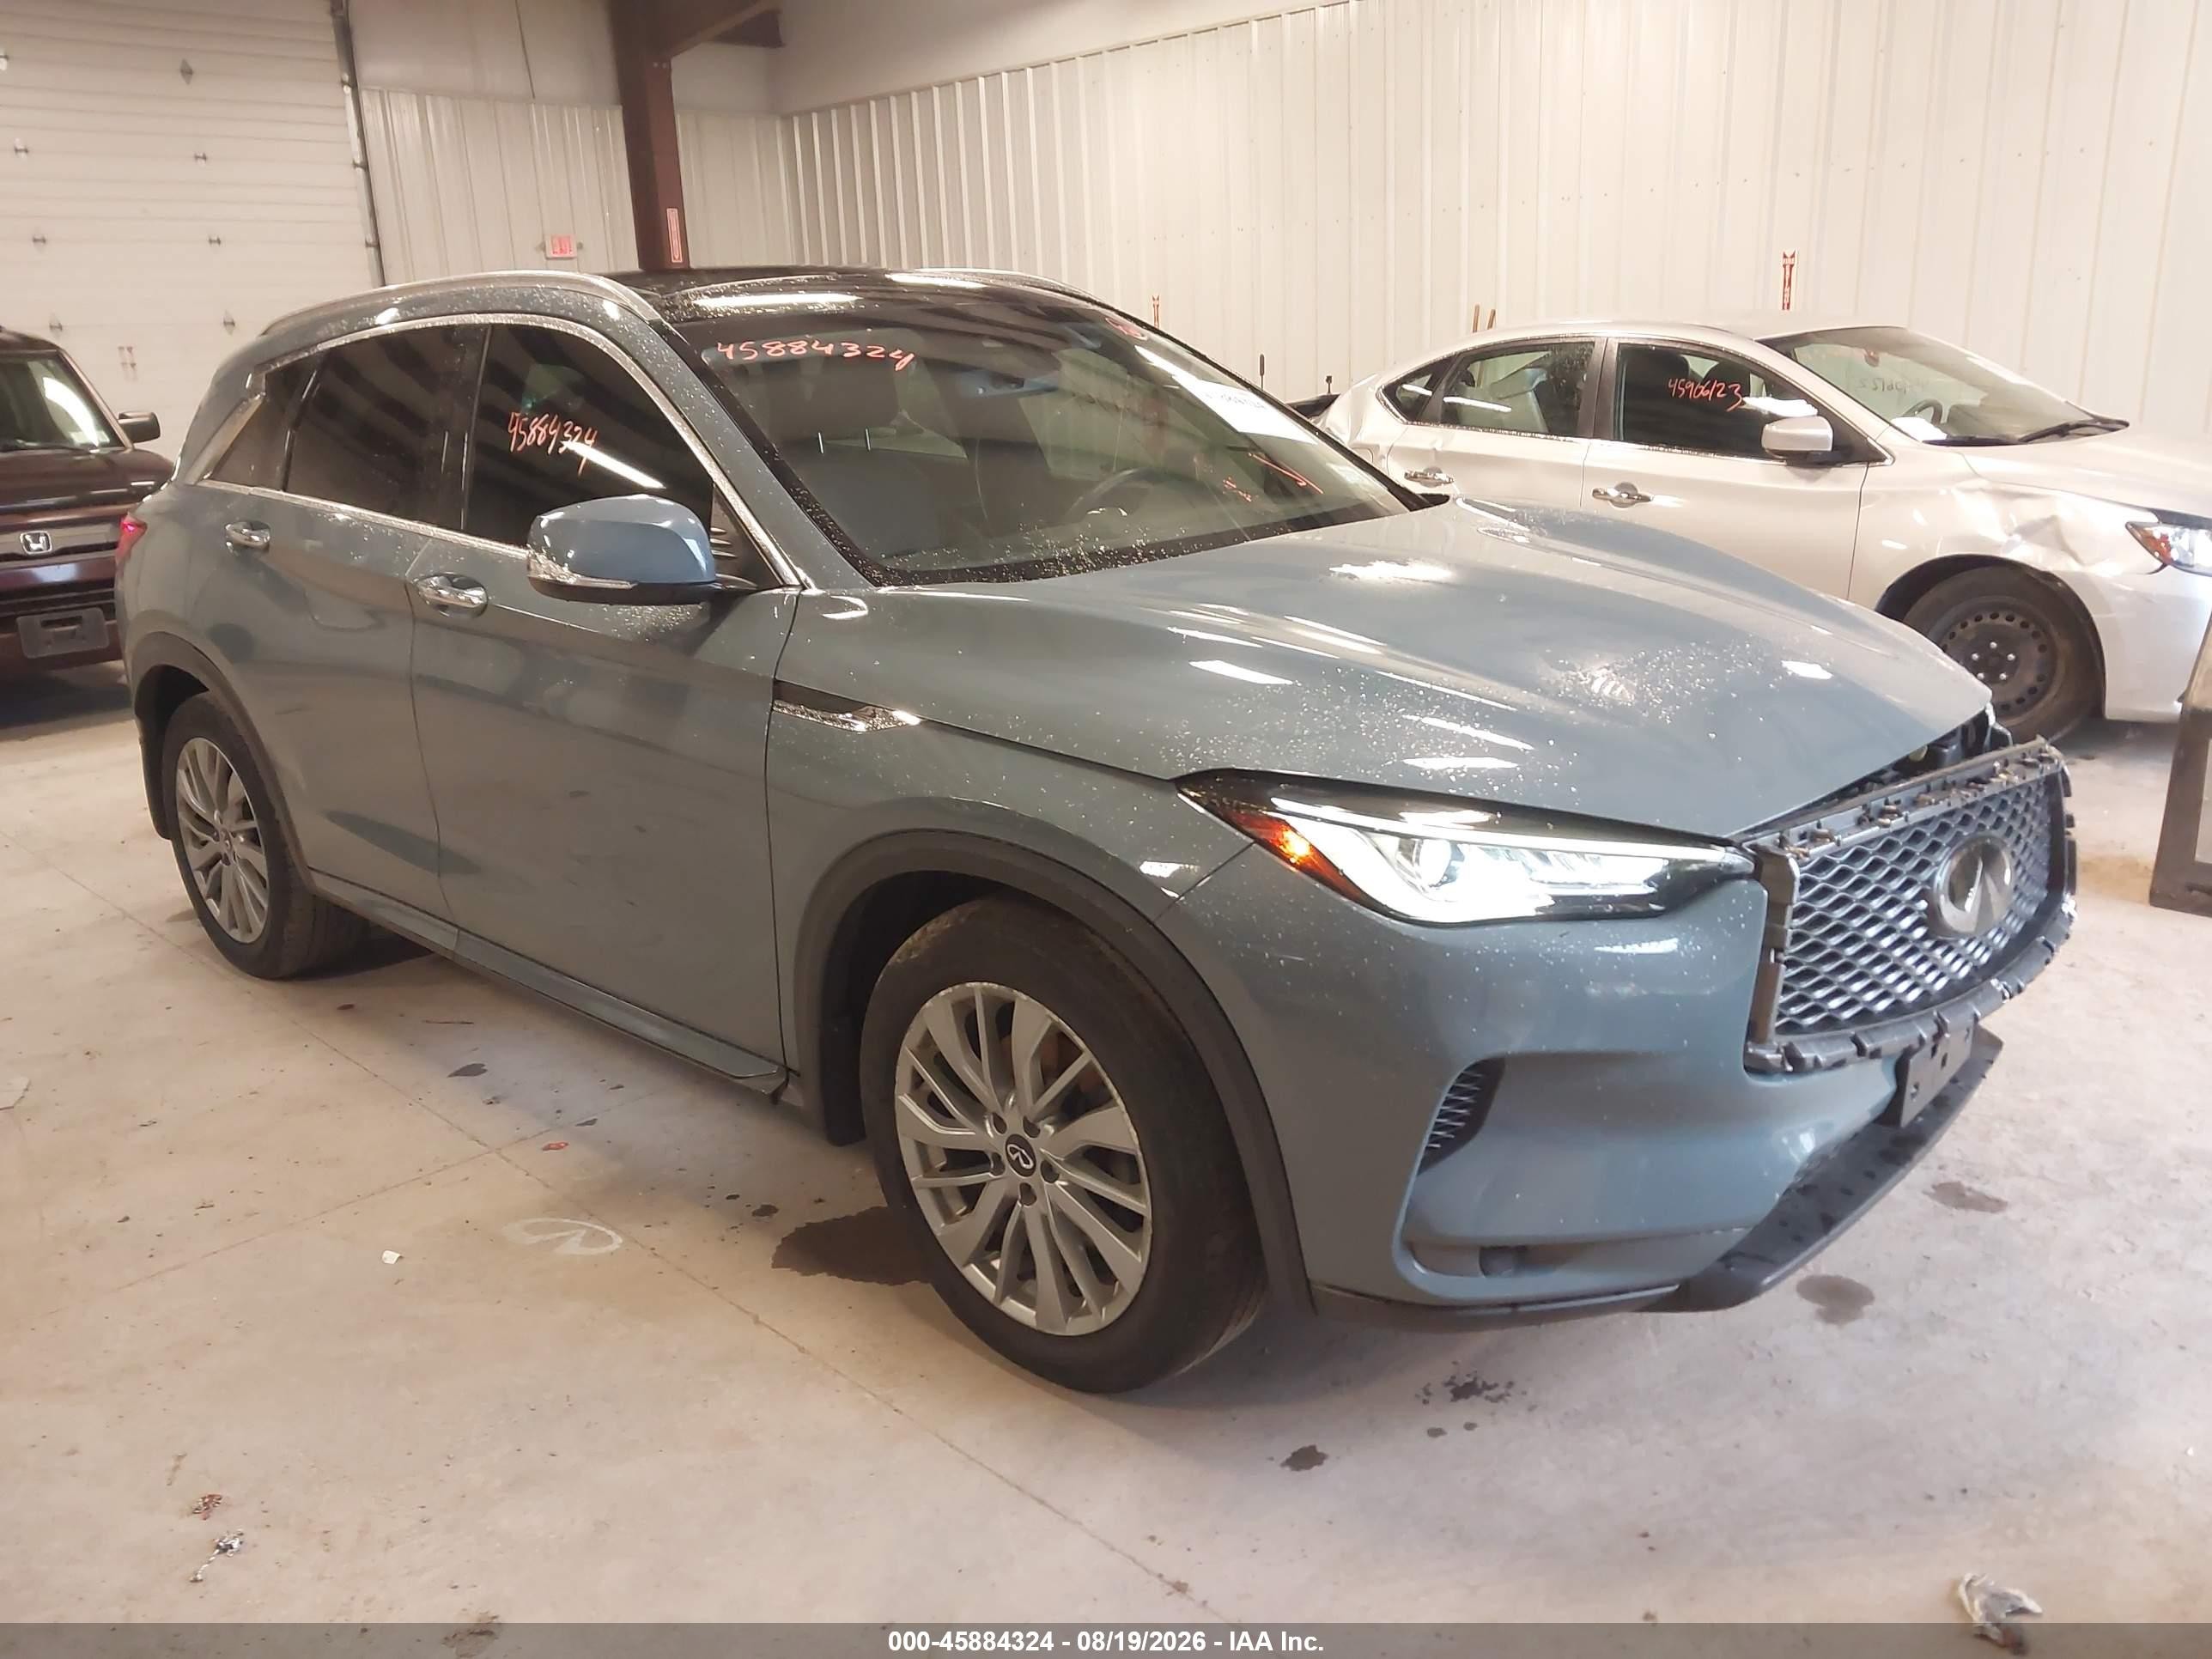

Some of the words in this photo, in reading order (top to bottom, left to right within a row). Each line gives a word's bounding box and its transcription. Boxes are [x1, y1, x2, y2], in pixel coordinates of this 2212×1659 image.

[716, 340, 915, 371] 45884324
[1668, 378, 1743, 412] 45906123
[507, 411, 599, 477] 45884324
